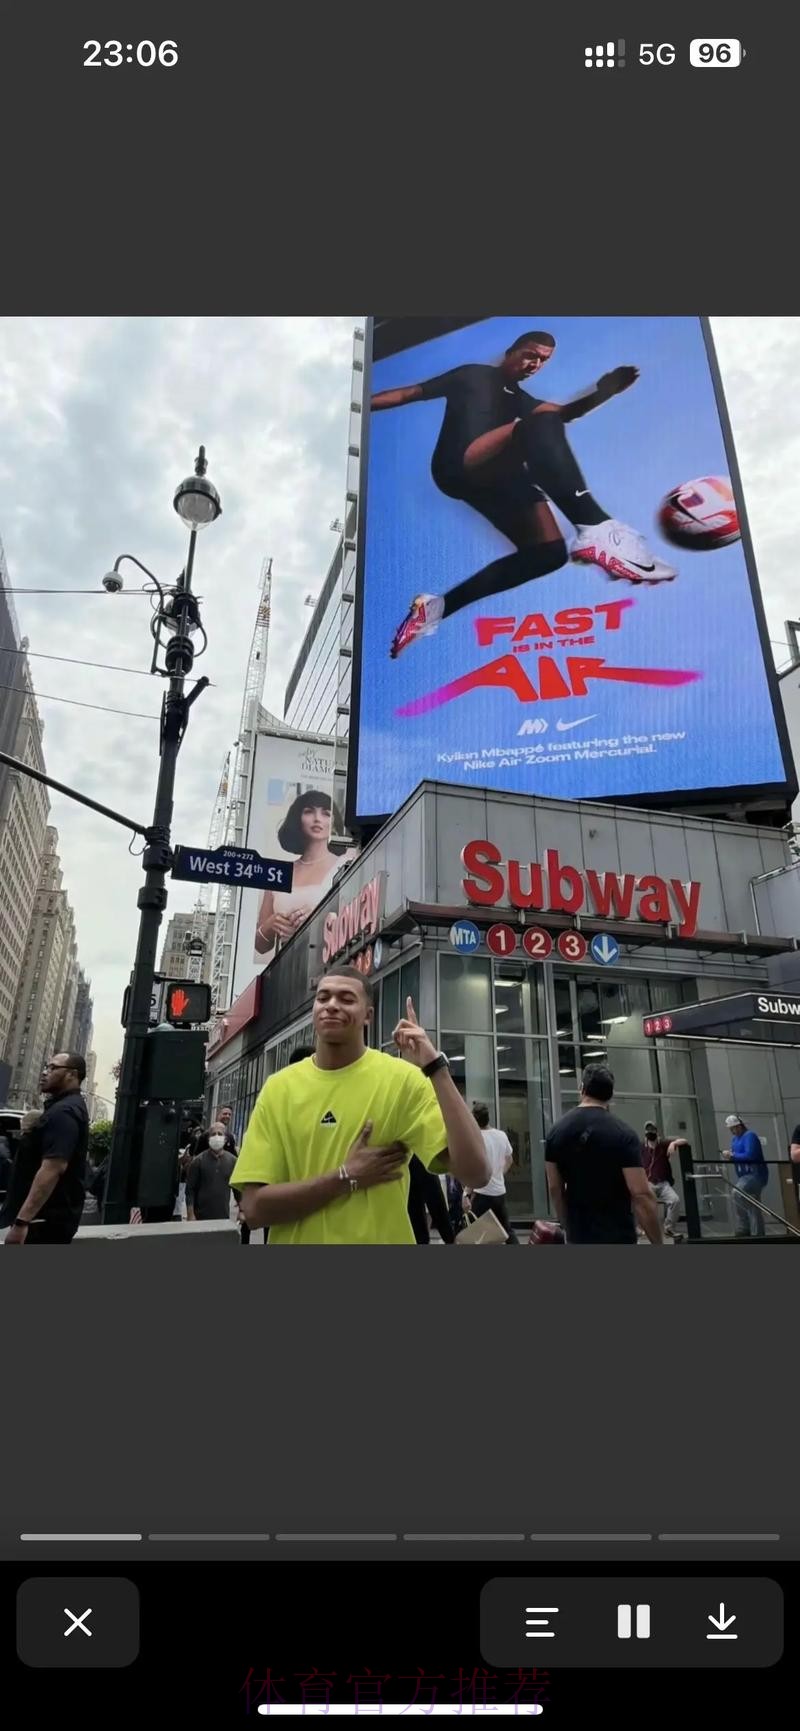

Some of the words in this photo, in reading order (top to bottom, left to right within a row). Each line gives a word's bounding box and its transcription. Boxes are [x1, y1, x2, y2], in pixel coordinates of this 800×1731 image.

[474, 597, 637, 646] FAST
[512, 644, 530, 653] IS
[534, 641, 553, 650] IN
[557, 635, 595, 647] THE
[394, 654, 704, 719] AIR
[437, 751, 479, 764] Kylian
[481, 743, 544, 759] Mbappé
[547, 738, 619, 752] featuring
[622, 734, 649, 745] the
[651, 731, 686, 742] new
[463, 760, 496, 772] Nike
[498, 757, 523, 768] Air
[526, 753, 571, 765] Zoom
[574, 743, 658, 761] Mercurial.
[189, 855, 231, 876] West
[234, 862, 263, 879] 34th
[267, 867, 283, 883] St
[223, 850, 236, 858] 200
[460, 840, 701, 937] Subway
[450, 926, 477, 946] MTA
[495, 929, 507, 951] 1
[530, 932, 546, 954] 2
[565, 935, 580, 957] 3
[758, 997, 800, 1015] Subw
